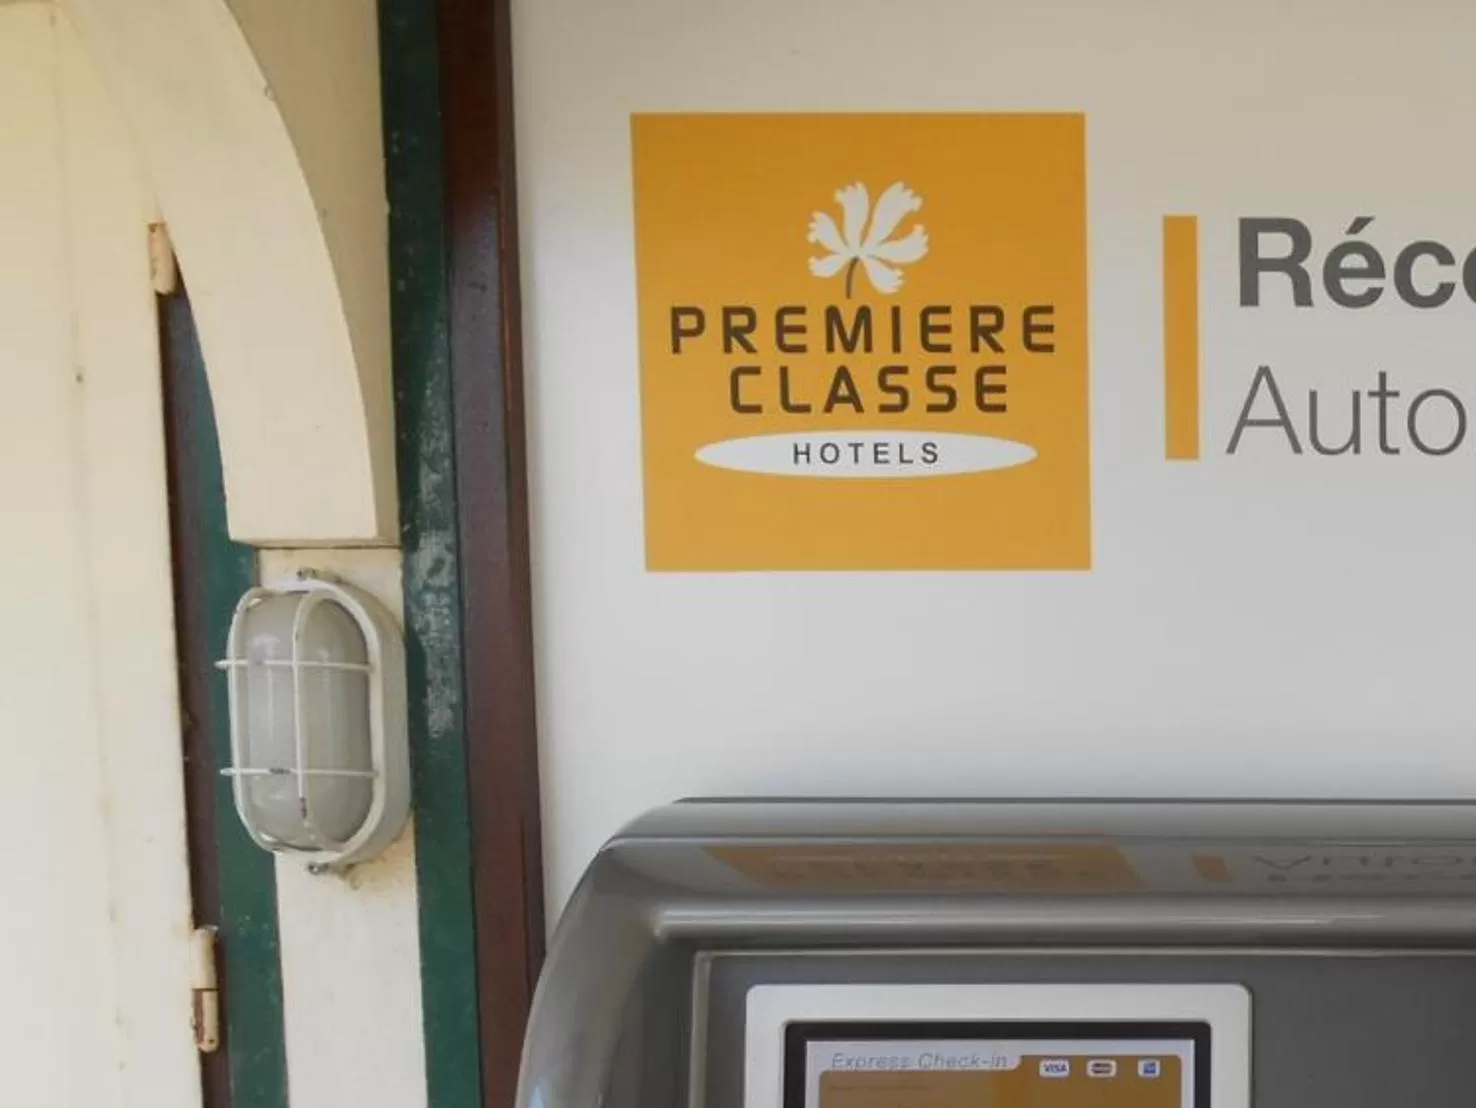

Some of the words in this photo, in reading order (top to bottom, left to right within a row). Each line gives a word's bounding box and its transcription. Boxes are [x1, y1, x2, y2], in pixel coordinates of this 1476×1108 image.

[671, 305, 1054, 354] PREMIERE
[730, 365, 1006, 414] CLASSE
[794, 442, 938, 464] HOTELS
[831, 1053, 912, 1070] Express
[918, 1053, 1007, 1070] Check-in
[1043, 1063, 1067, 1073] VISA
